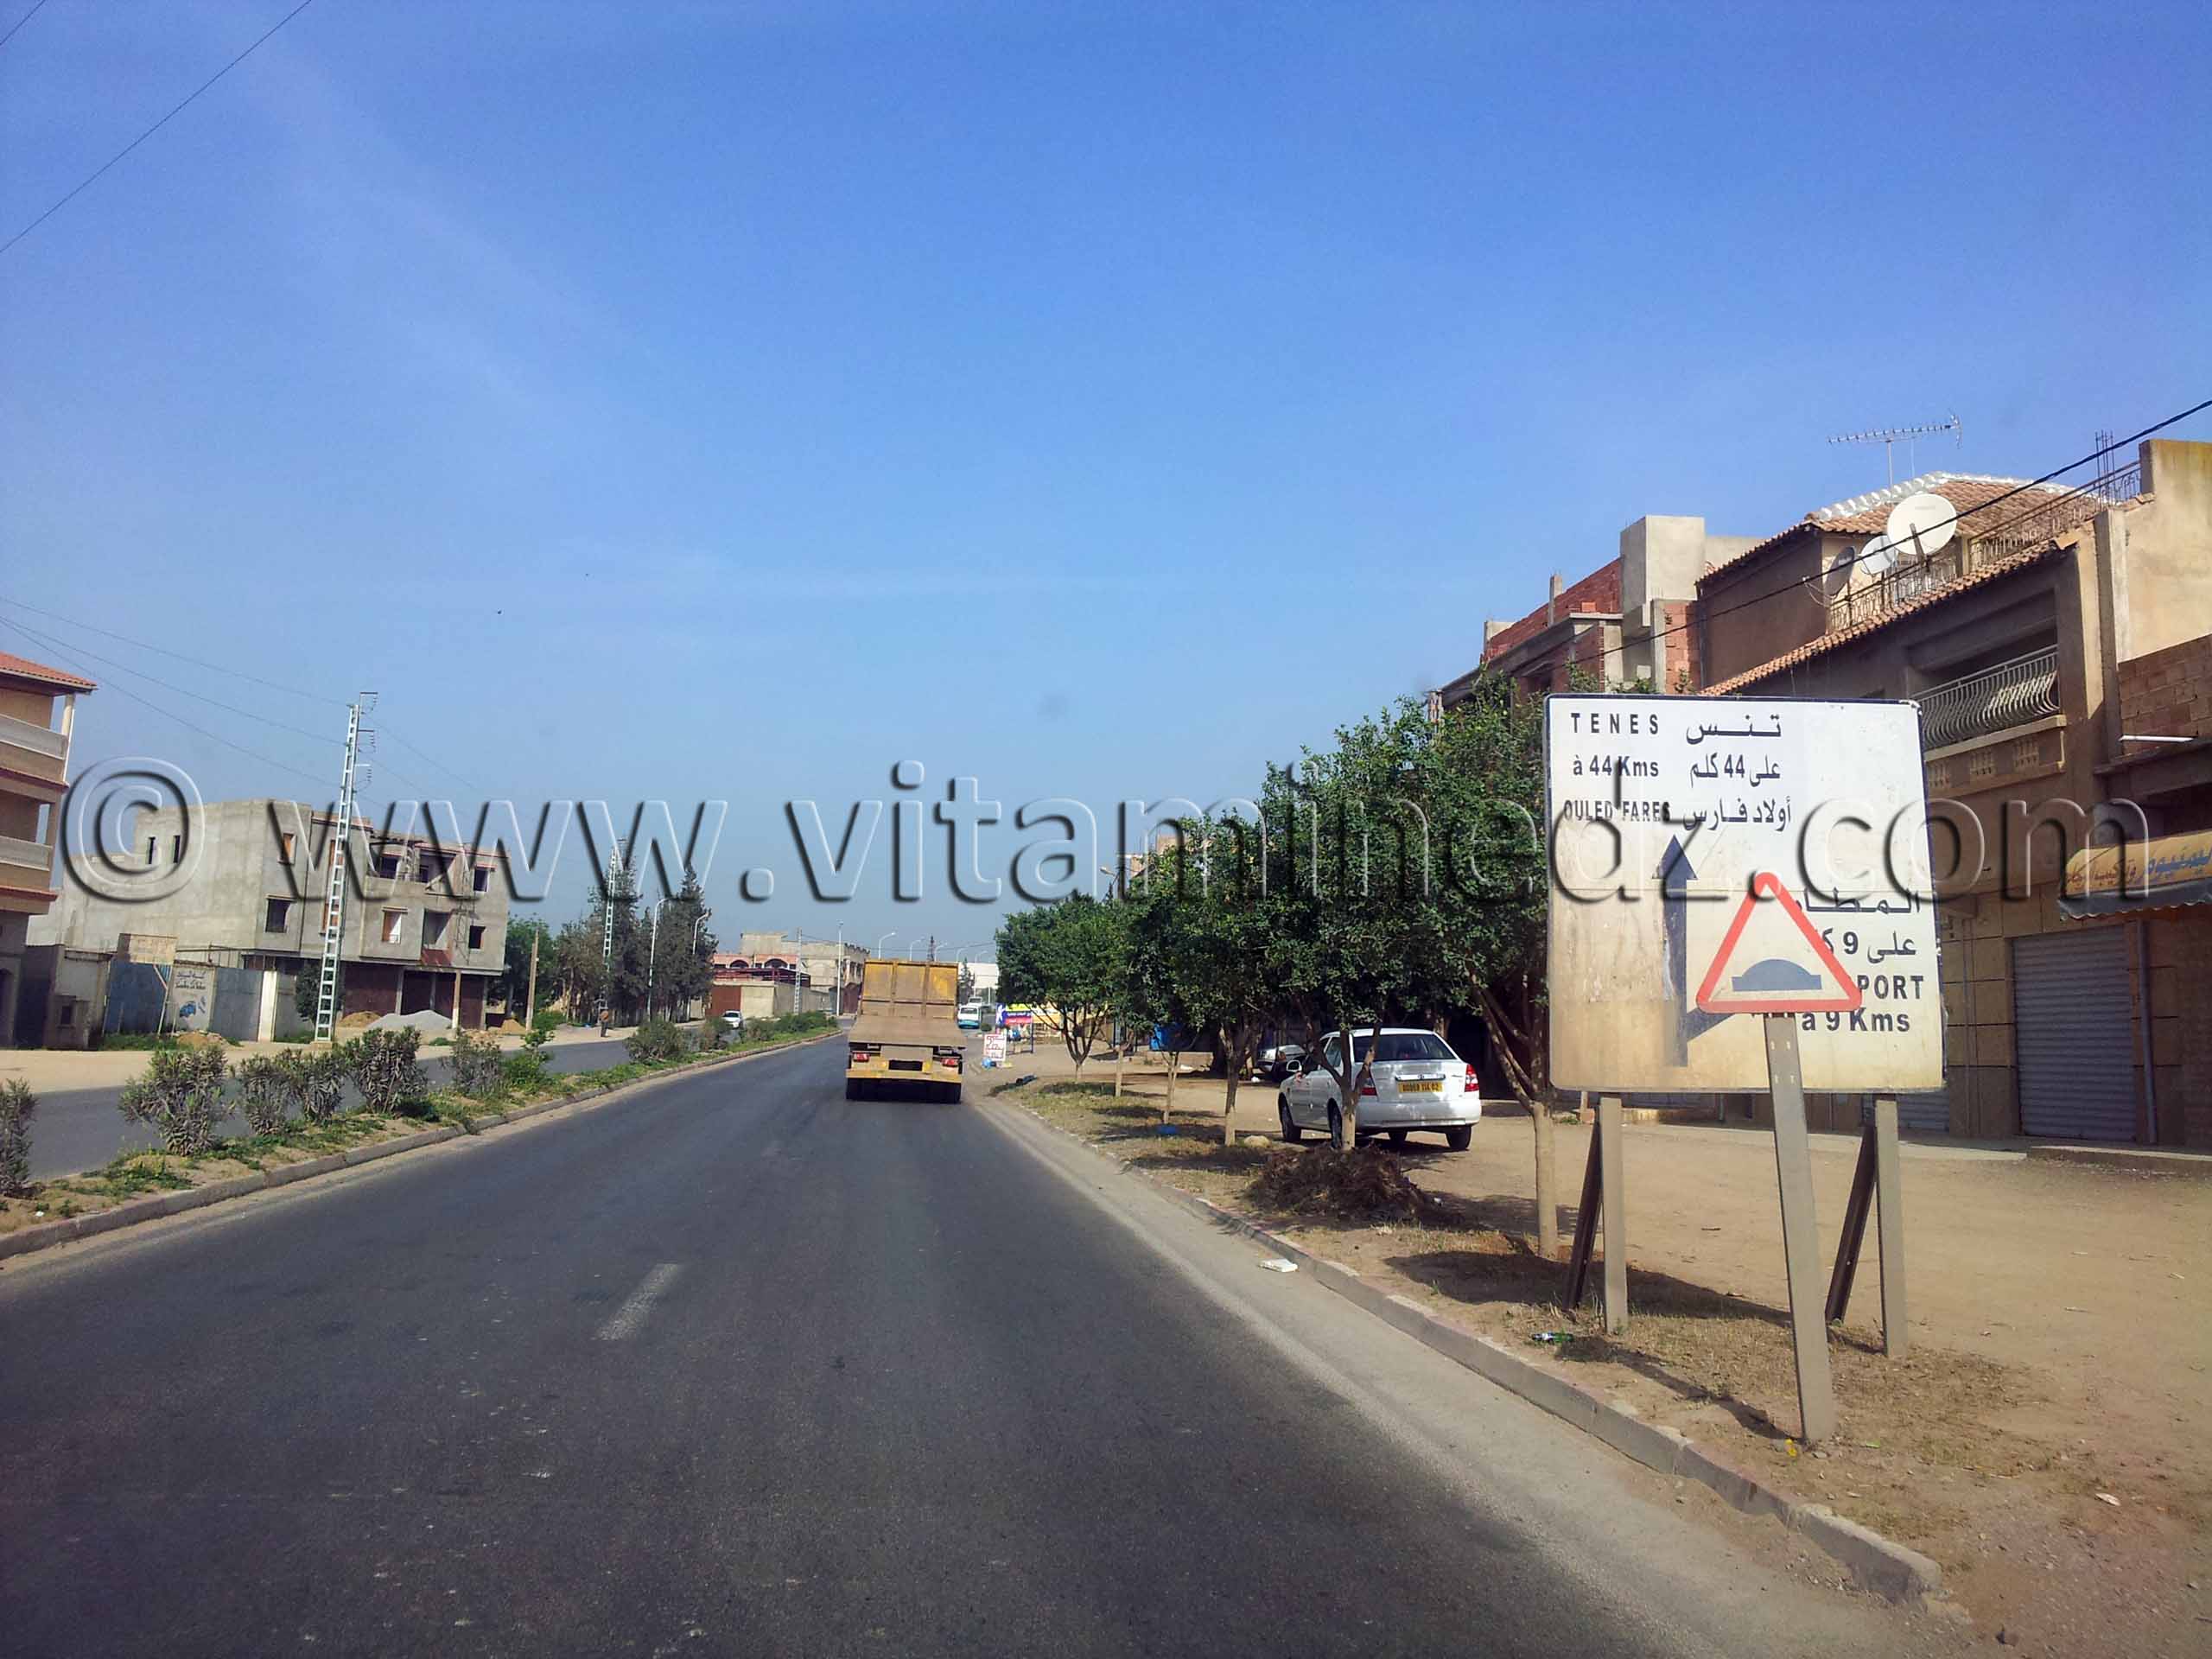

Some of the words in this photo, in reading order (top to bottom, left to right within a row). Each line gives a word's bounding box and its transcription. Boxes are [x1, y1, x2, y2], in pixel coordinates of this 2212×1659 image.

[1570, 712, 1659, 735] TENES
[1685, 713, 1782, 745] تنس
[1573, 754, 1583, 776] à
[1589, 754, 1612, 776] 44
[1617, 755, 1660, 777] Kms
[1689, 752, 1719, 788] كلم
[1724, 753, 1745, 778] 44
[1749, 753, 1781, 787] على
[1562, 799, 1613, 822] OULED
[1622, 800, 1671, 823] FARES
[1681, 796, 1748, 831] فارس
[1752, 795, 1791, 832] أولاد
[1842, 931, 1859, 955] 9
[1866, 930, 1917, 964] على
[1826, 1012, 1840, 1031] 9
[1849, 1007, 1911, 1033] Kms
